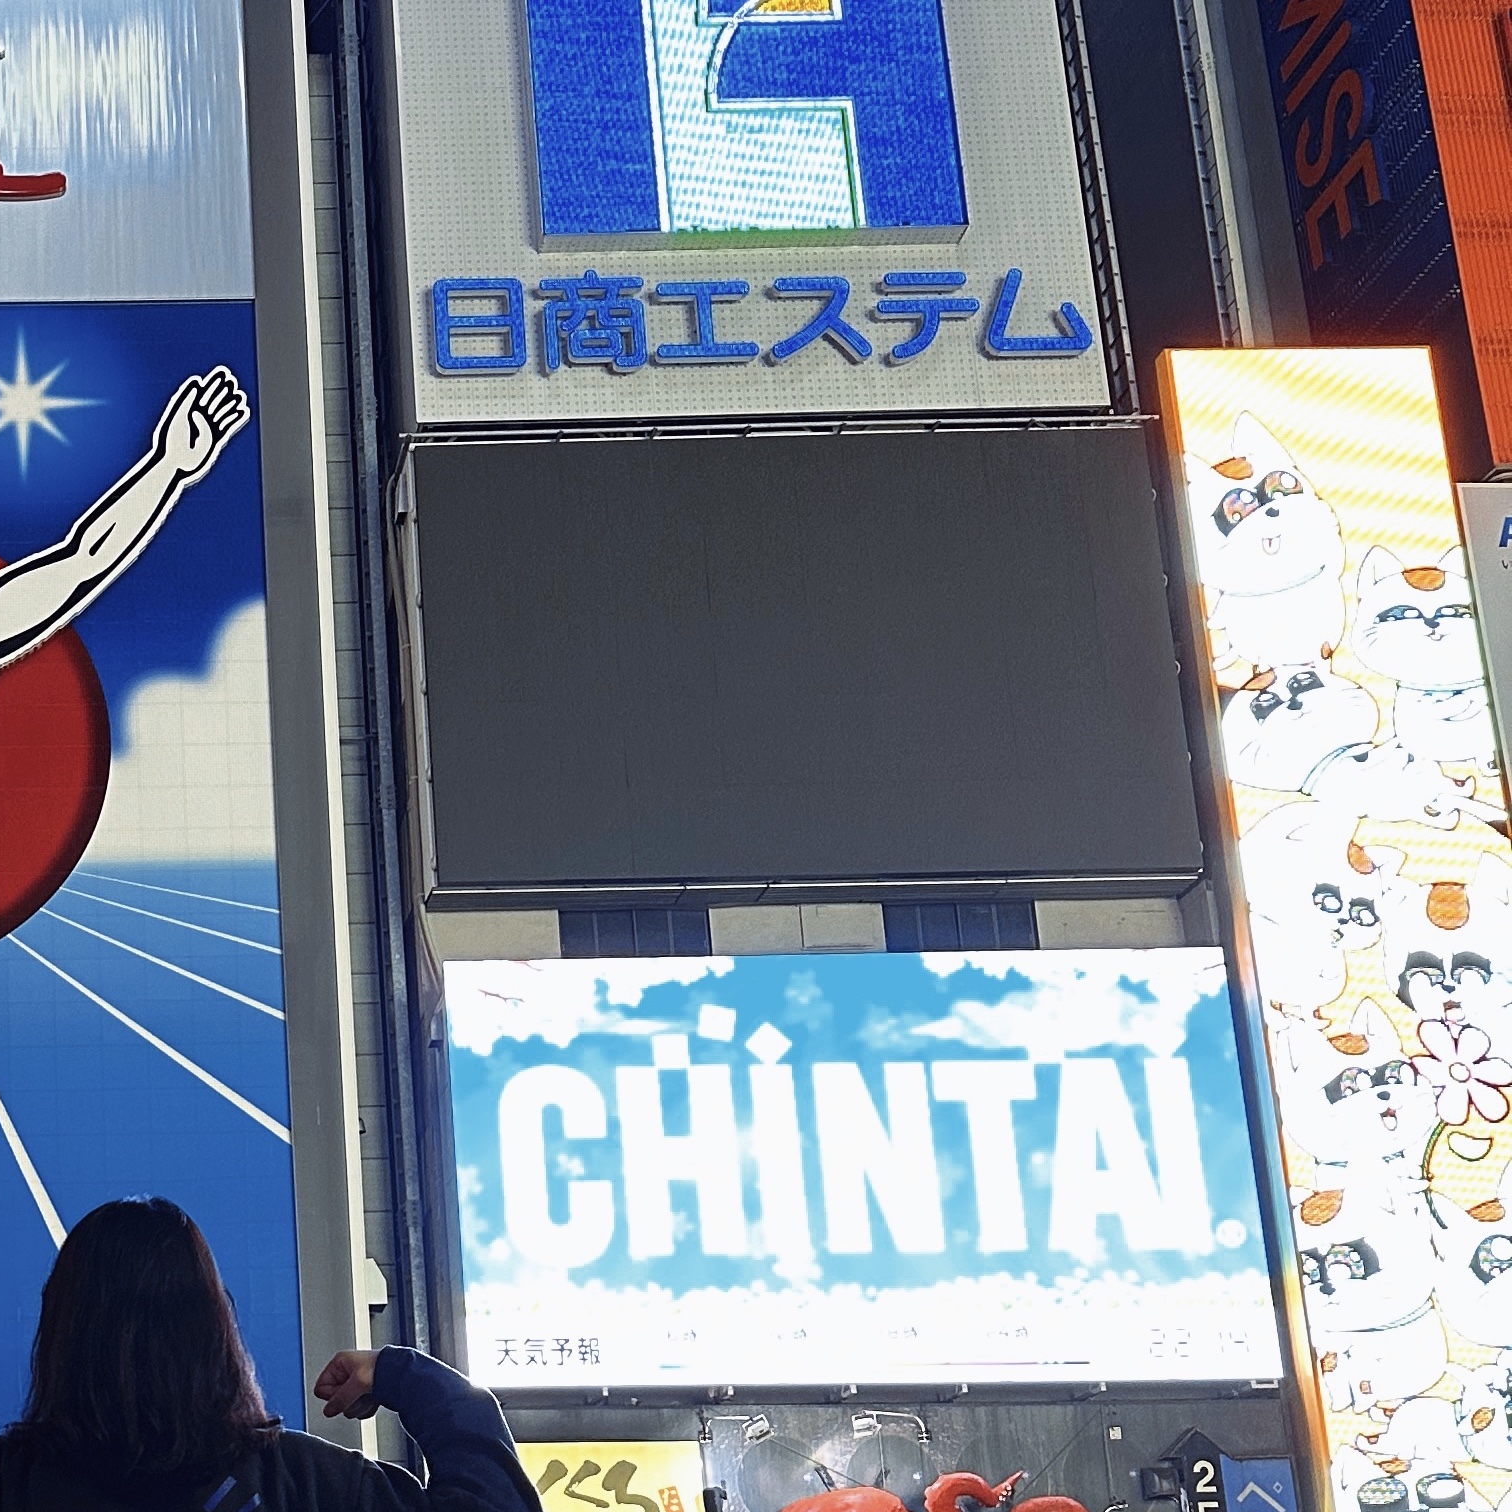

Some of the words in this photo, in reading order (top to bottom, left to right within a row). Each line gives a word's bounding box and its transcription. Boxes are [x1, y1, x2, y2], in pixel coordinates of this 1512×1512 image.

[430, 269, 1093, 375] 日商エステム
[495, 1336, 601, 1368] 天気予報
